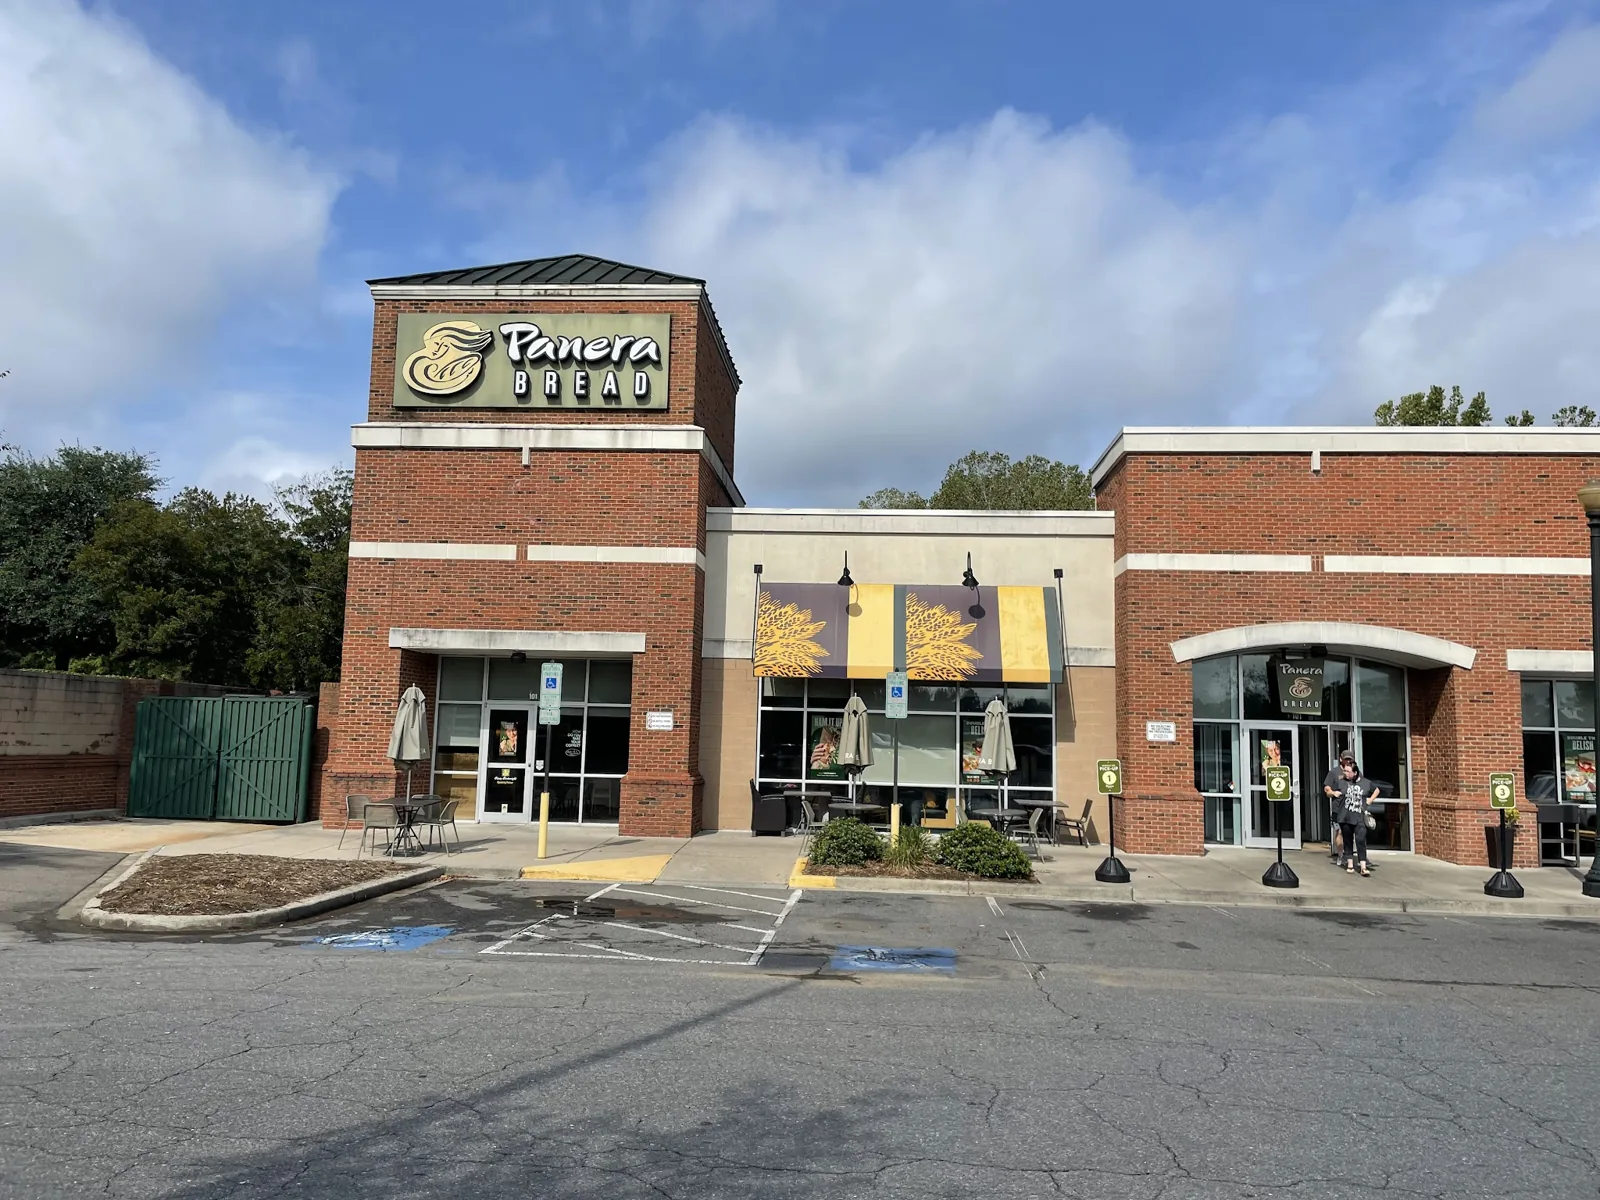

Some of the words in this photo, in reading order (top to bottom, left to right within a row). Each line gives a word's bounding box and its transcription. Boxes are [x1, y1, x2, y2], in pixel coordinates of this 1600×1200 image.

[499, 322, 661, 363] Panera
[514, 370, 650, 396] BREAD
[1280, 663, 1323, 675] Panera
[1283, 700, 1320, 708] BREAD
[970, 725, 985, 735] DELI
[1572, 740, 1594, 751] DELISH
[1107, 774, 1112, 783] 1
[1275, 780, 1282, 789] 2
[1499, 788, 1506, 797] 3
